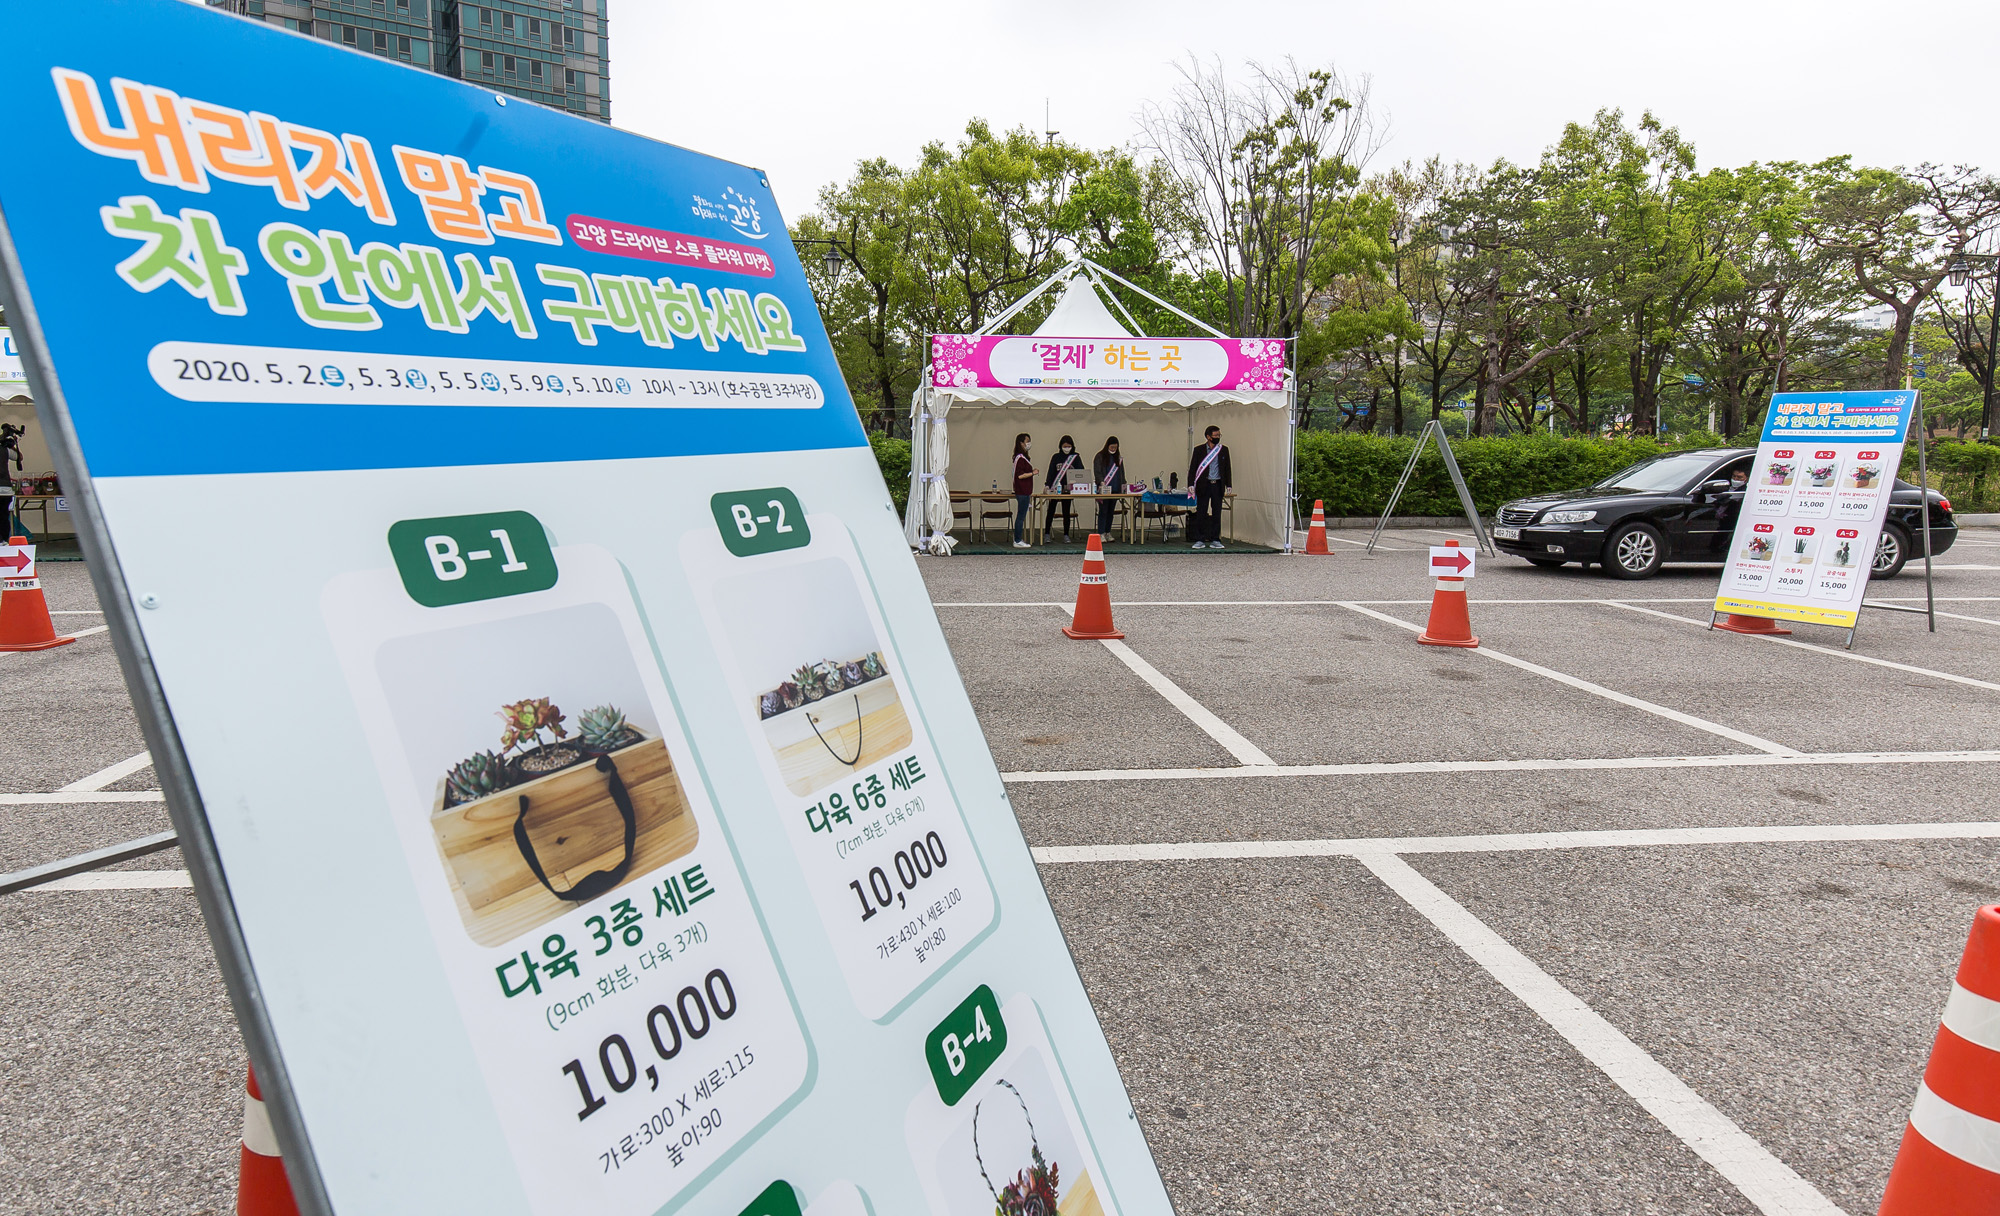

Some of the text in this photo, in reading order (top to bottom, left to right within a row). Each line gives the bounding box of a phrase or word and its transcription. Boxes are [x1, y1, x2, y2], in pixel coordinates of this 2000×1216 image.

[53, 67, 563, 246] 내리지 말고
[727, 203, 762, 234] 고양
[573, 221, 772, 272] 고양 드라이브 스루 플라워 마켓
[101, 195, 806, 355] 차 안에서 구매하세요
[1103, 344, 1151, 372] 하는
[1159, 345, 1182, 372] 곳
[642, 378, 676, 397] 10시
[692, 380, 720, 397] 13시
[722, 380, 774, 399] (호수공원
[774, 381, 817, 400] 3주차장)
[1777, 402, 1844, 415] 내리지 말고
[1774, 415, 1899, 428] 차 안에서 구매하세요
[730, 499, 793, 539] B-2
[1758, 499, 1783, 507] 10,000
[1799, 501, 1824, 509] 15,000
[1841, 503, 1868, 511] 10,000
[424, 528, 528, 582] B-1
[1738, 573, 1763, 582] 15,000
[1778, 577, 1804, 585] 20,000
[1820, 581, 1847, 590] 15,000
[804, 754, 927, 835] 다육 6종 세트
[835, 795, 926, 860] (7cm 화분, 다육 6개)
[849, 829, 948, 922] 10,000
[495, 863, 716, 998] 다육 3종 세트
[545, 921, 709, 1031] (9cm 화분, 다육 3개)
[561, 968, 738, 1122] 10,000
[941, 1004, 993, 1078] B-4
